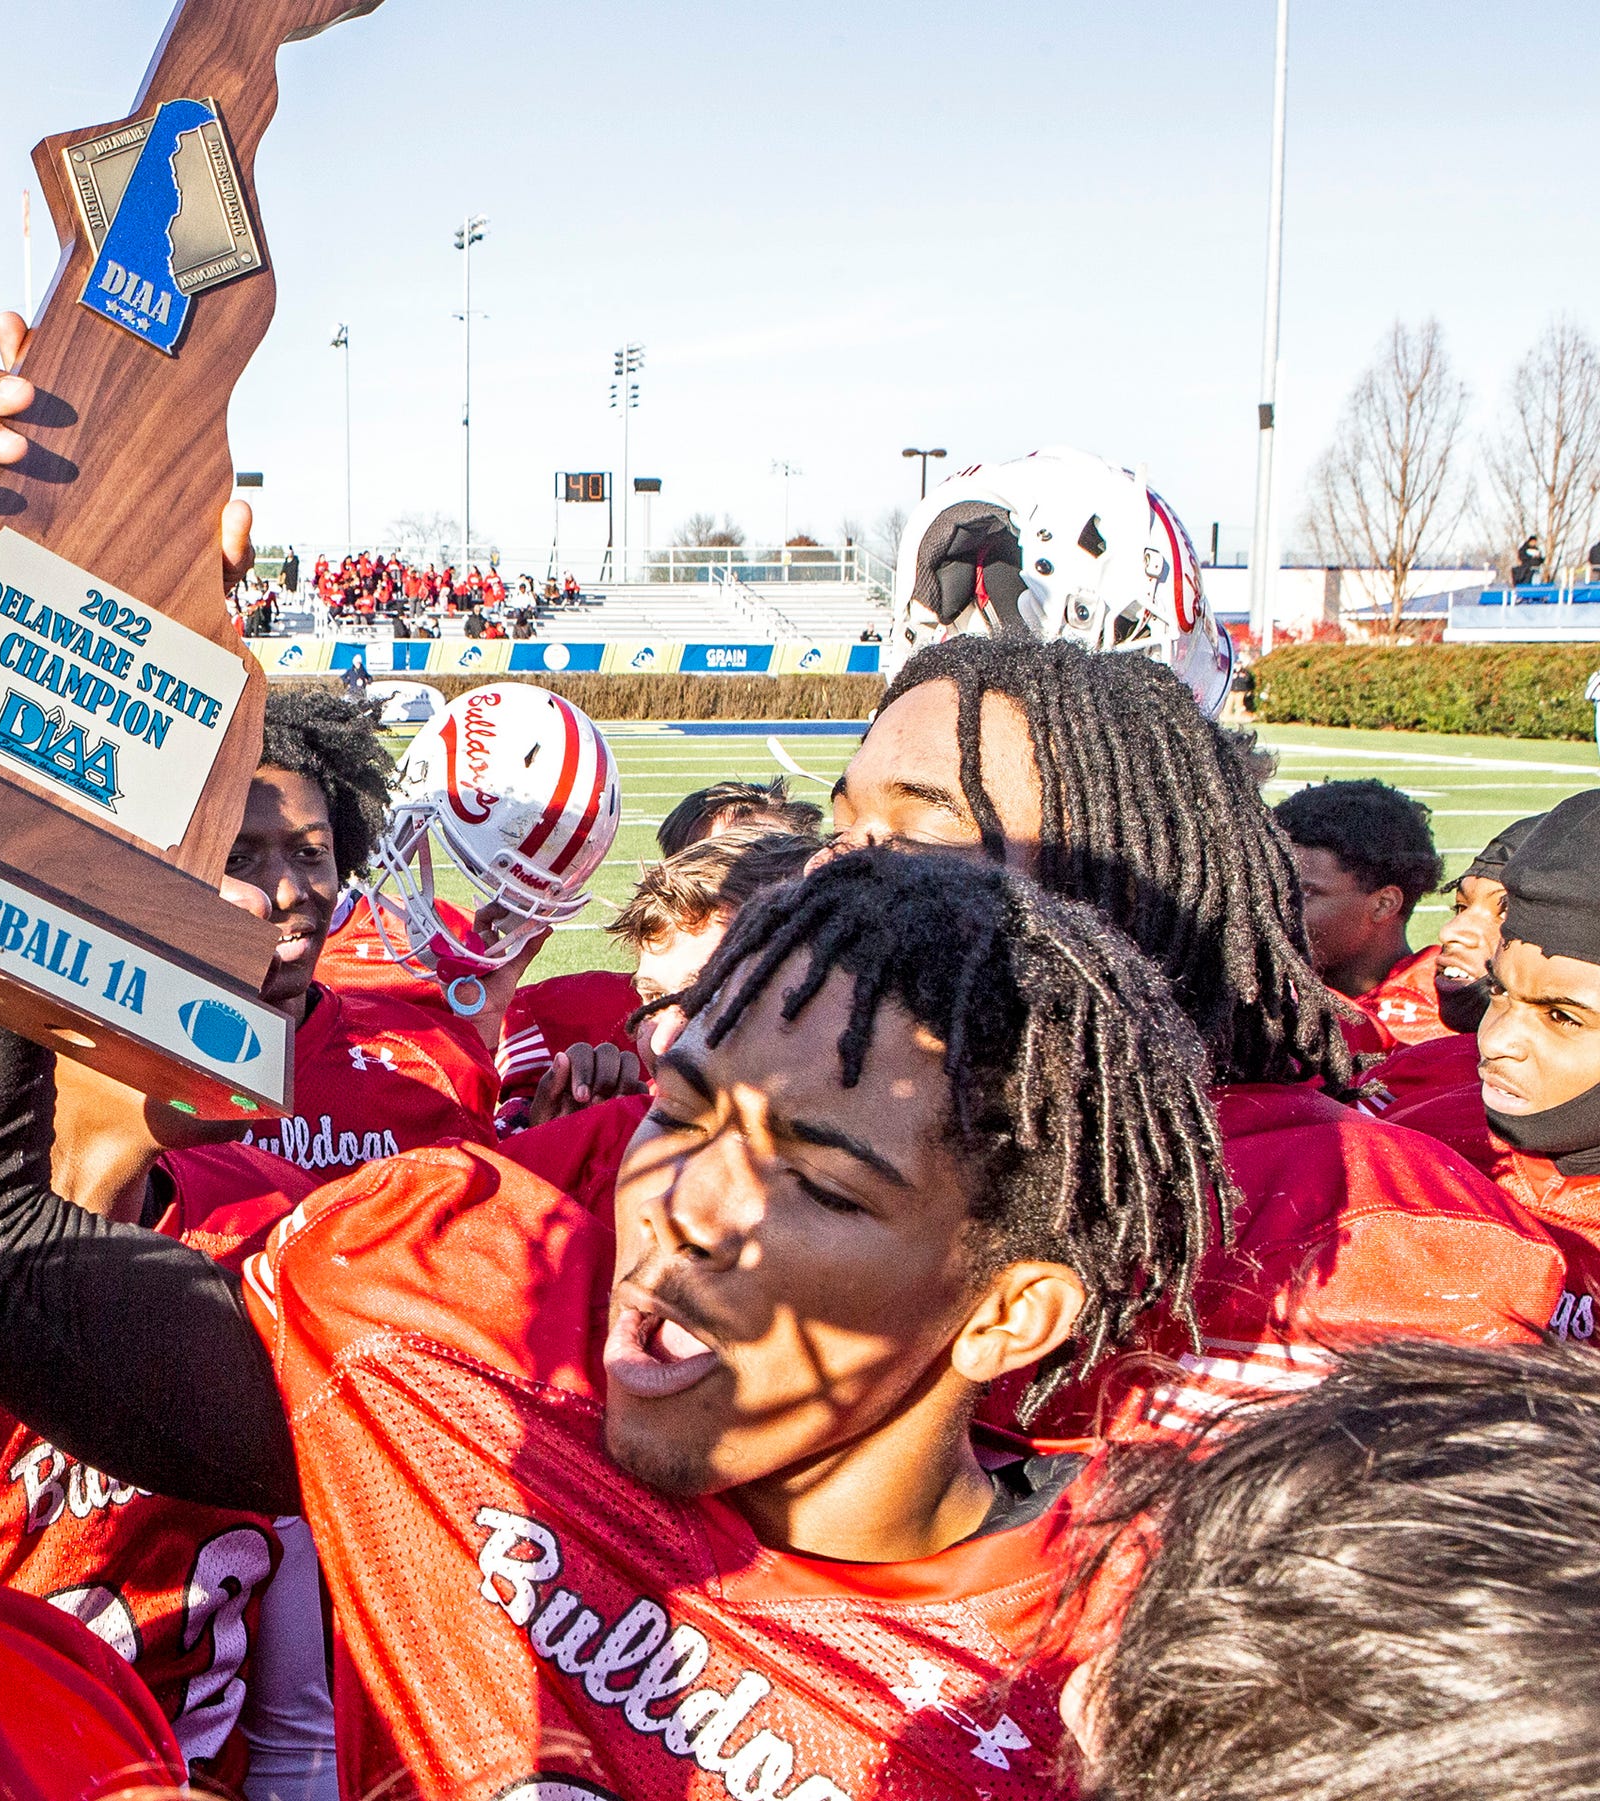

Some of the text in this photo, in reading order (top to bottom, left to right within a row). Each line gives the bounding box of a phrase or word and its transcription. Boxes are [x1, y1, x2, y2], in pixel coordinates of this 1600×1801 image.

[92, 126, 147, 156] DELAWARE
[78, 176, 105, 230] ATHLETIC
[208, 140, 246, 237] INTERSCHOLASTIC
[98, 260, 174, 325] DIAA
[177, 256, 240, 290] ASSOCIATION
[569, 474, 603, 500] 40
[79, 589, 152, 647] 2022
[706, 648, 747, 662] GRAIN
[137, 662, 223, 729] STATE
[510, 863, 551, 891] Riddell
[102, 959, 147, 1015] 1A
